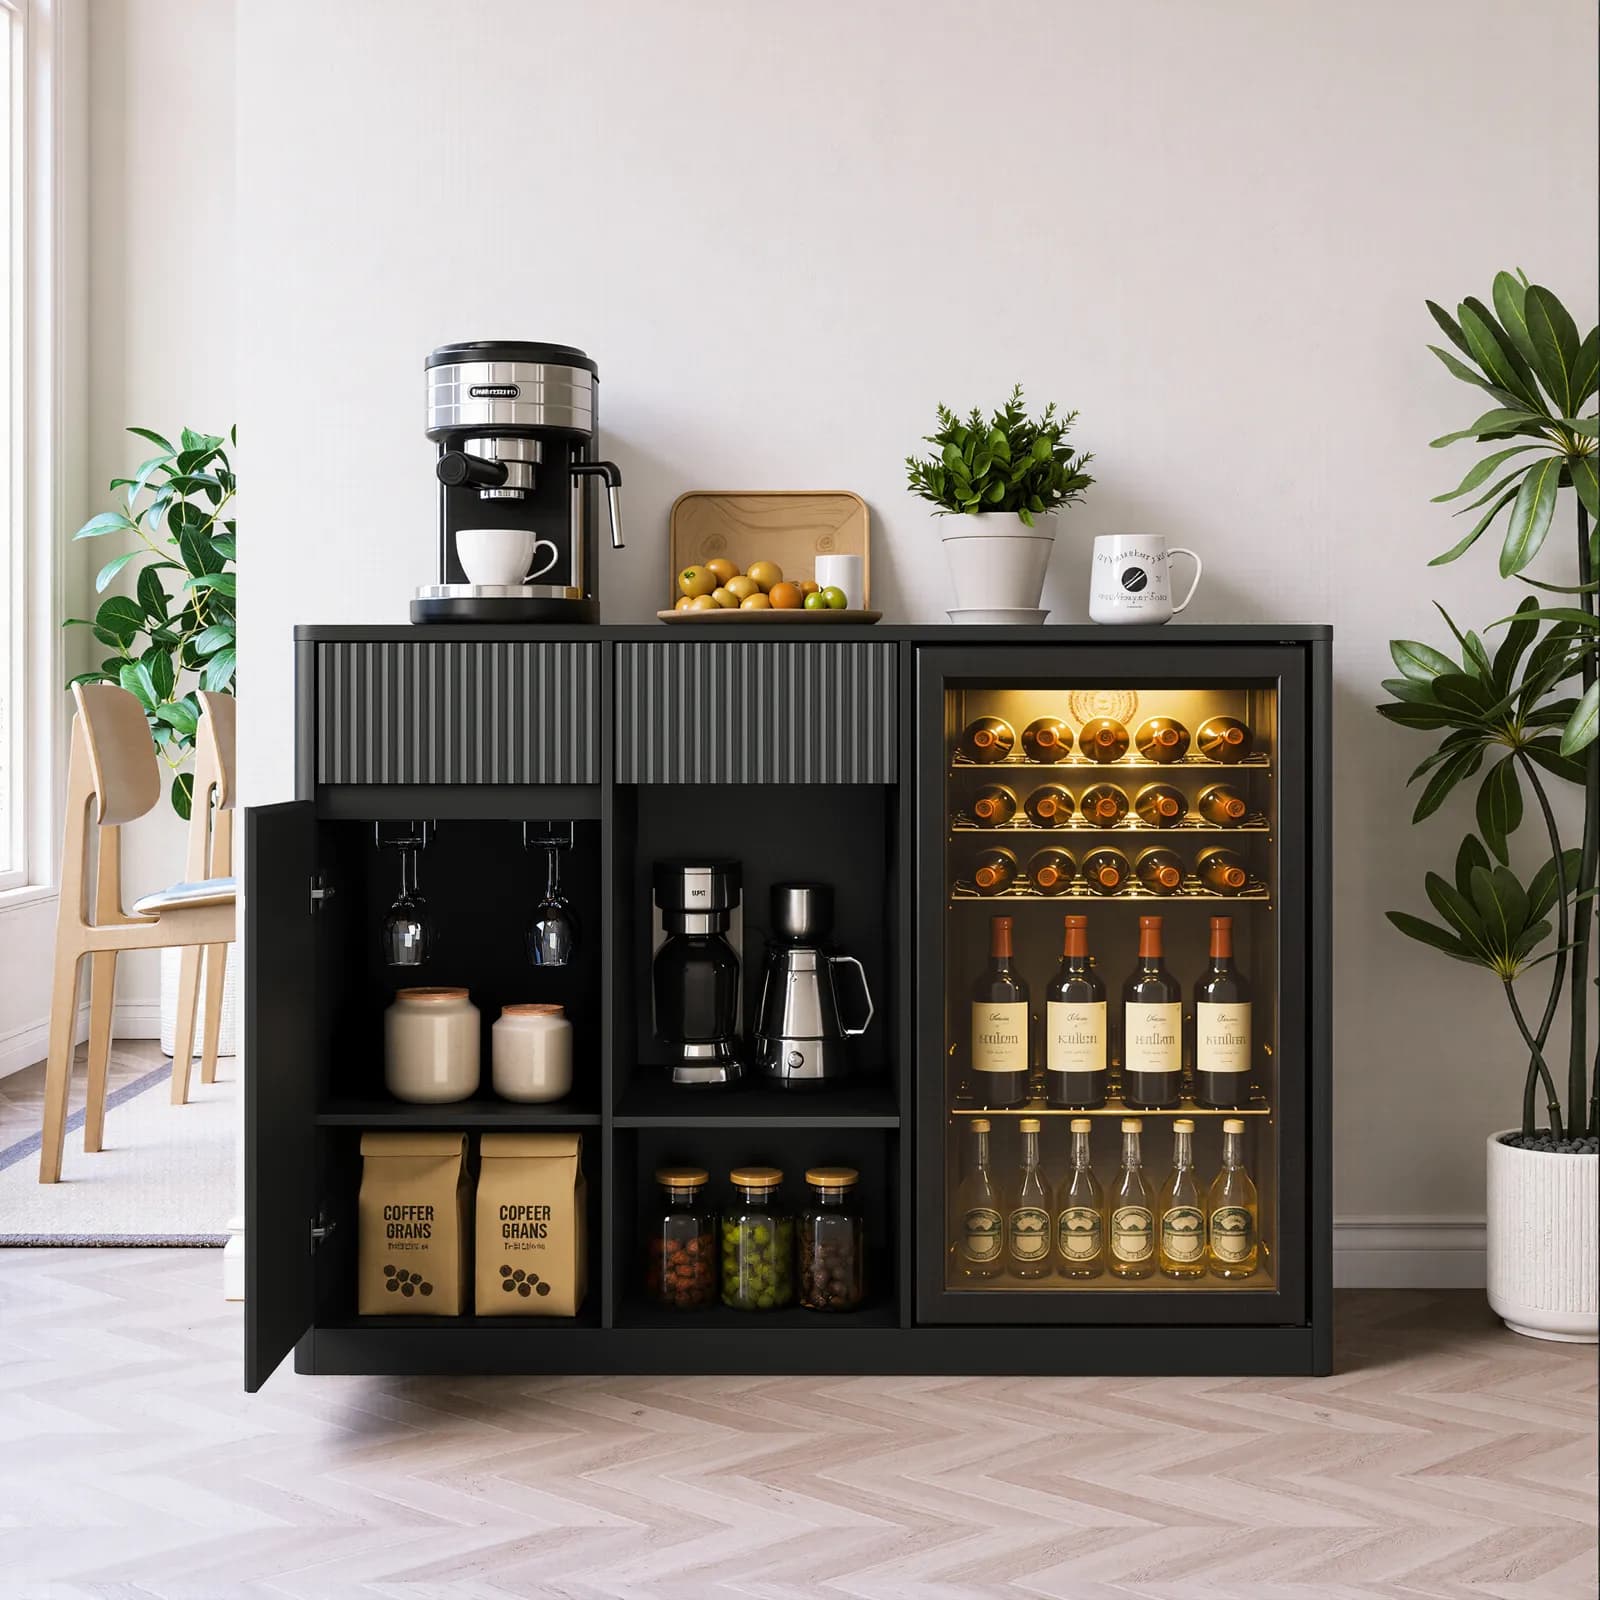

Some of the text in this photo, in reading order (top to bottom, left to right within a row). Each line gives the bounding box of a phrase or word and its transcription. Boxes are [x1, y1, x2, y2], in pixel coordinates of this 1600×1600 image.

[383, 1205, 434, 1221] COFFER
[499, 1205, 551, 1221] COPEER
[386, 1223, 432, 1239] GRANS
[502, 1223, 549, 1239] GRANS
